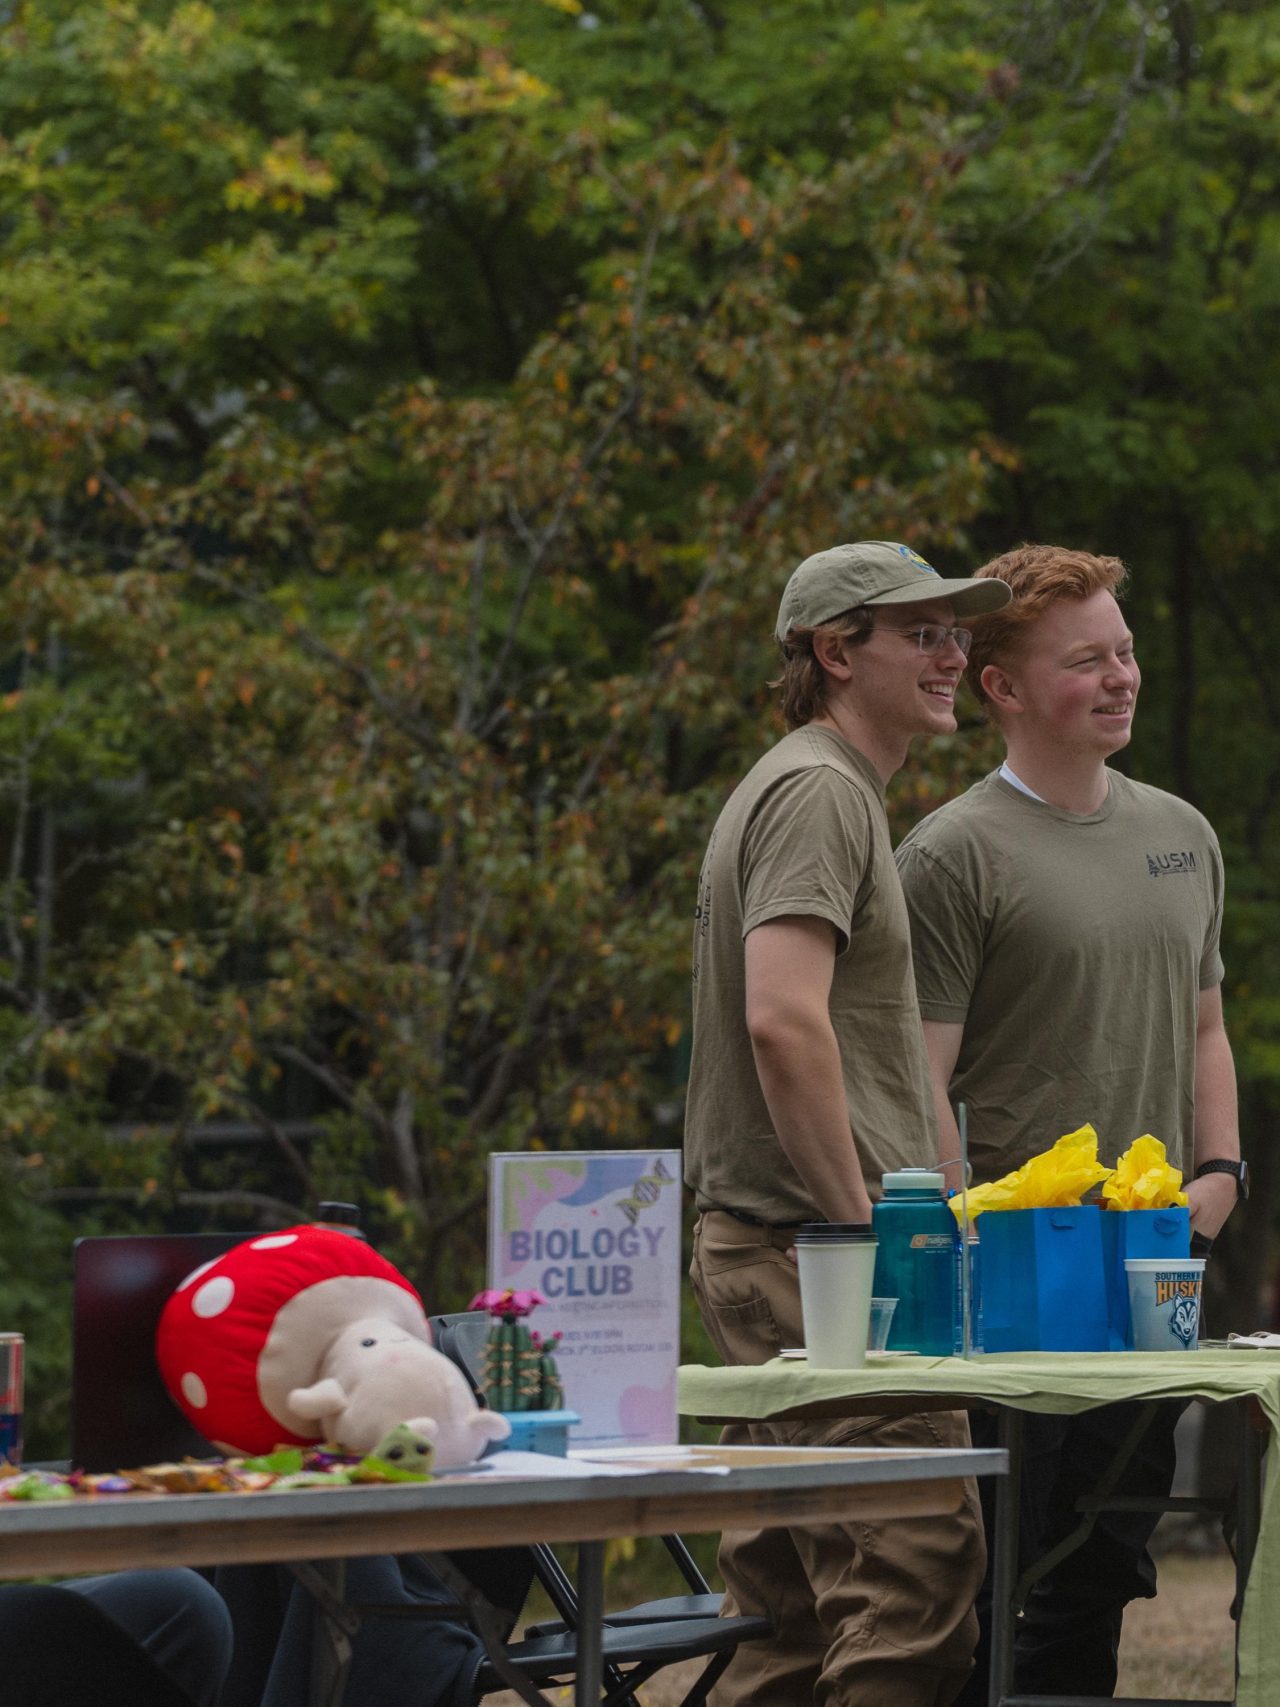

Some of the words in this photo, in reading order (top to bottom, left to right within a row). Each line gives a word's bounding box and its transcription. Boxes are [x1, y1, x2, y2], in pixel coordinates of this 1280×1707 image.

[1156, 852, 1196, 869] USM
[510, 1227, 665, 1261] BIOLOGY
[542, 1265, 633, 1298] CLUB
[1155, 1272, 1194, 1280] SOUTHERN
